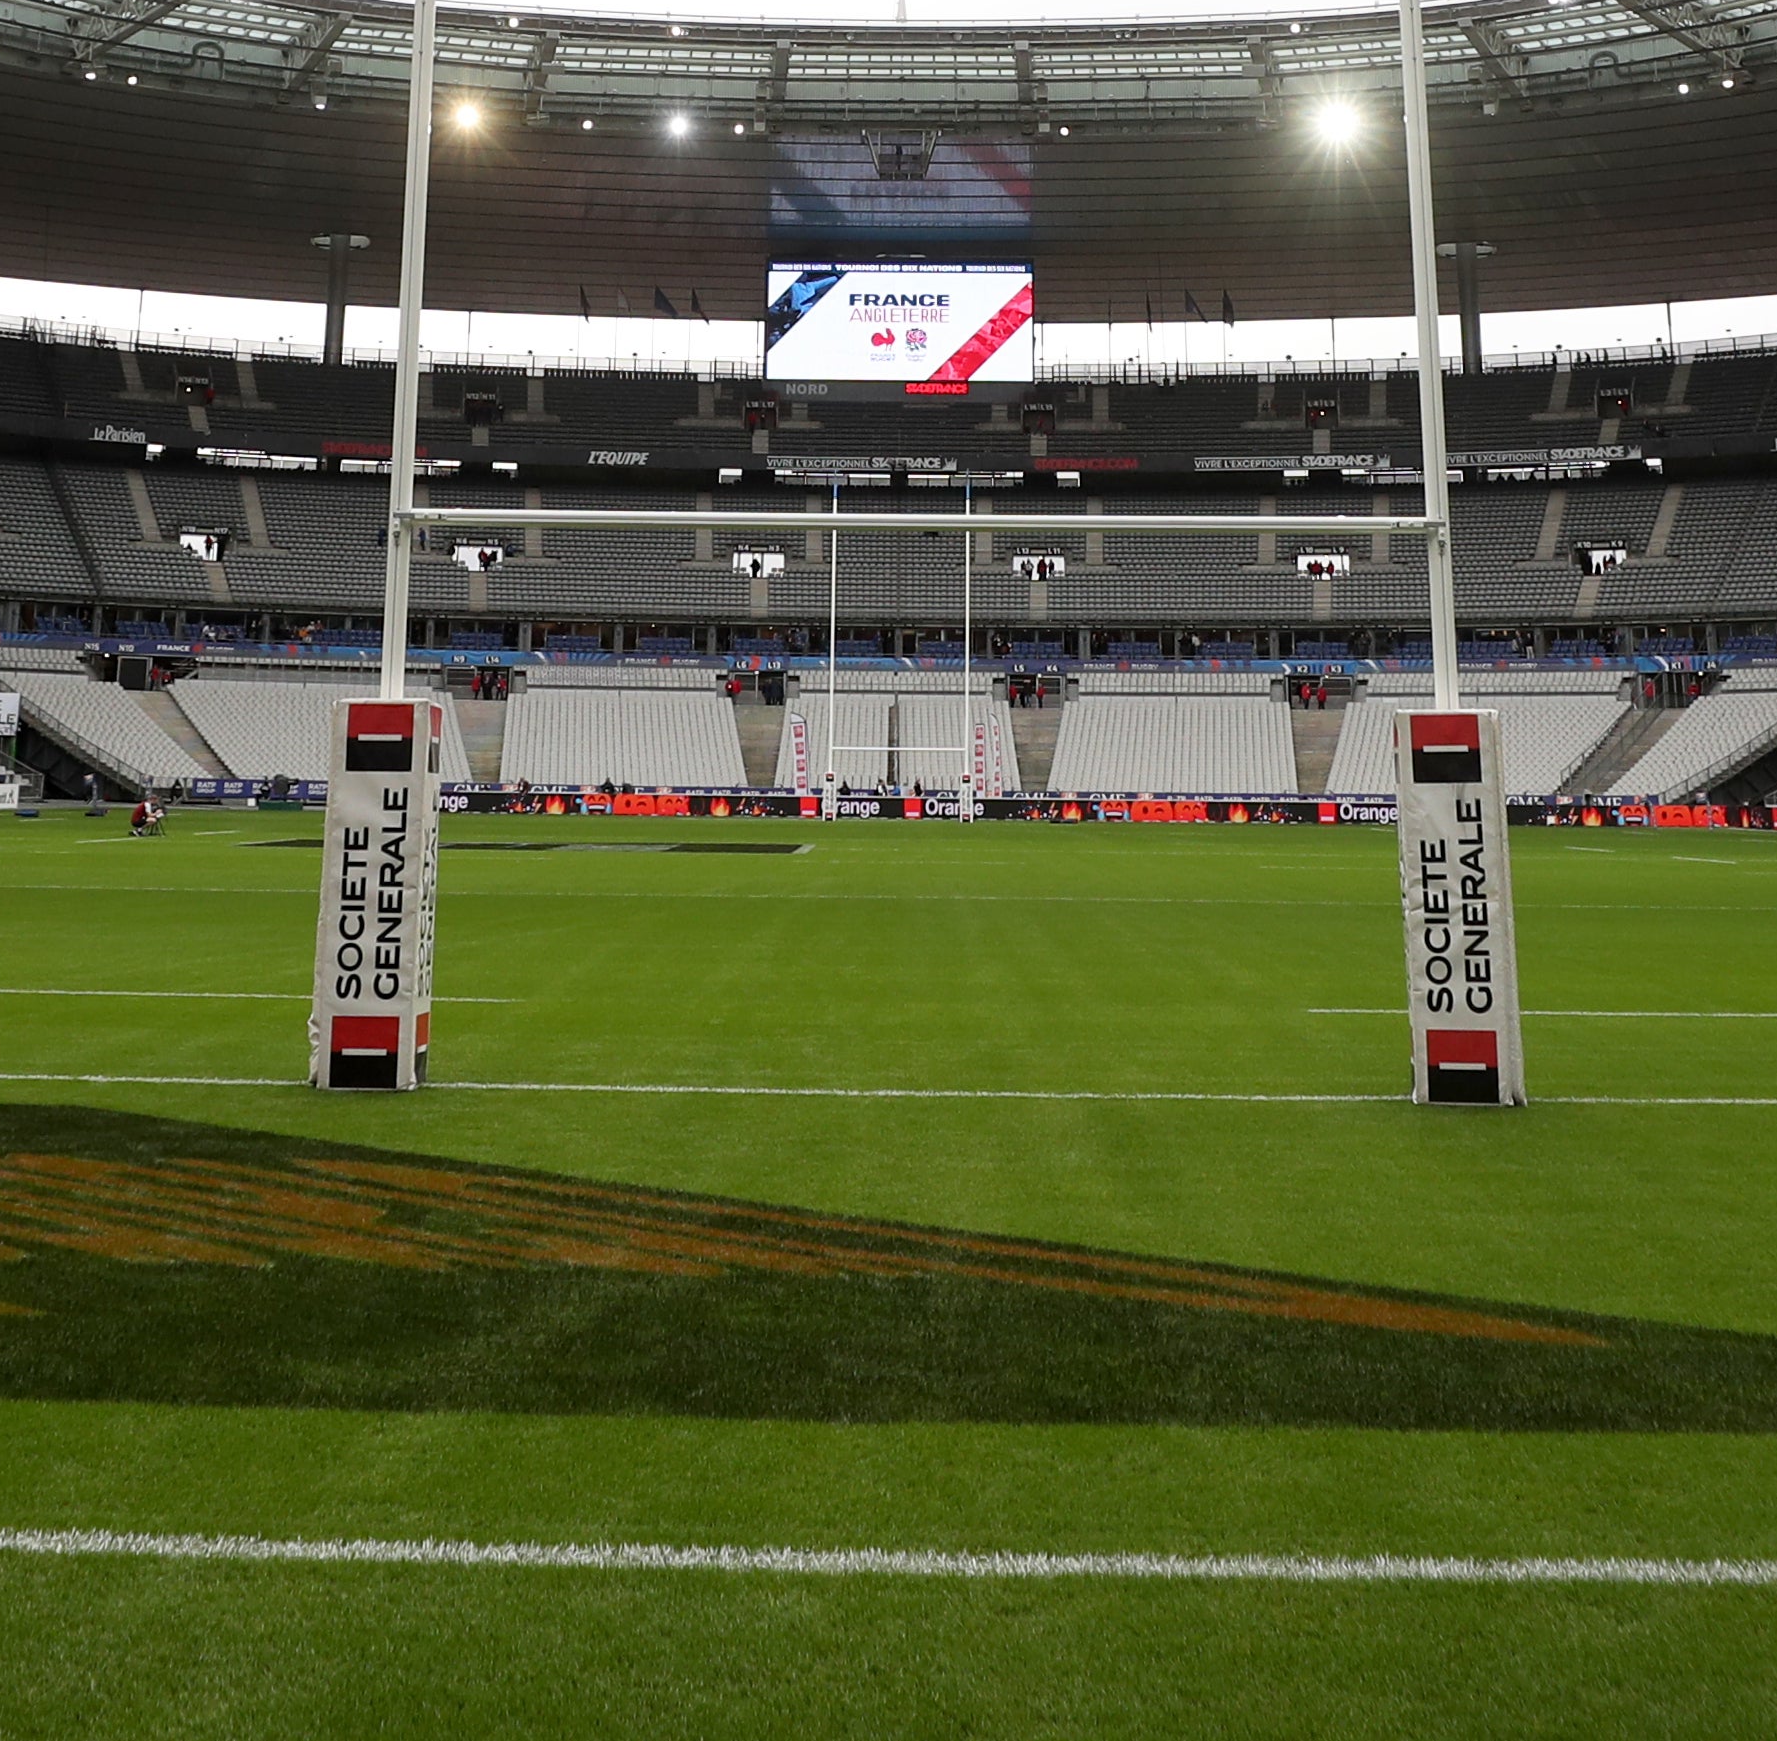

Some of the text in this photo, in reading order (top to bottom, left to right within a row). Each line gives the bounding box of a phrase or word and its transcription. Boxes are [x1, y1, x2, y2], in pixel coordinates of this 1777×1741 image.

[849, 293, 950, 306] FRANCE
[849, 308, 950, 323] ANGLETERRE
[785, 383, 828, 395] NORD
[587, 451, 650, 467] L'EQUIPE
[766, 457, 871, 469] VIVRE L'EXCEPTIONNEL
[1194, 459, 1222, 469] VIVRE
[1224, 458, 1301, 469] L'EXCEPTIONNEL
[1445, 454, 1469, 464] IVRE
[1469, 452, 1549, 464] L'EXCEPTIONNEL
[156, 644, 190, 653] FRANCE
[1296, 665, 1308, 673] K2
[224, 781, 244, 789] RATP
[438, 795, 469, 811] nge
[822, 801, 880, 817] range
[924, 799, 985, 816] Orane
[1339, 804, 1398, 824] Orange
[374, 787, 409, 1001] GENERALE
[336, 826, 369, 1000] SOCIETE
[1455, 797, 1493, 1015] GENERALE
[1419, 838, 1454, 1014] SOCIETE
